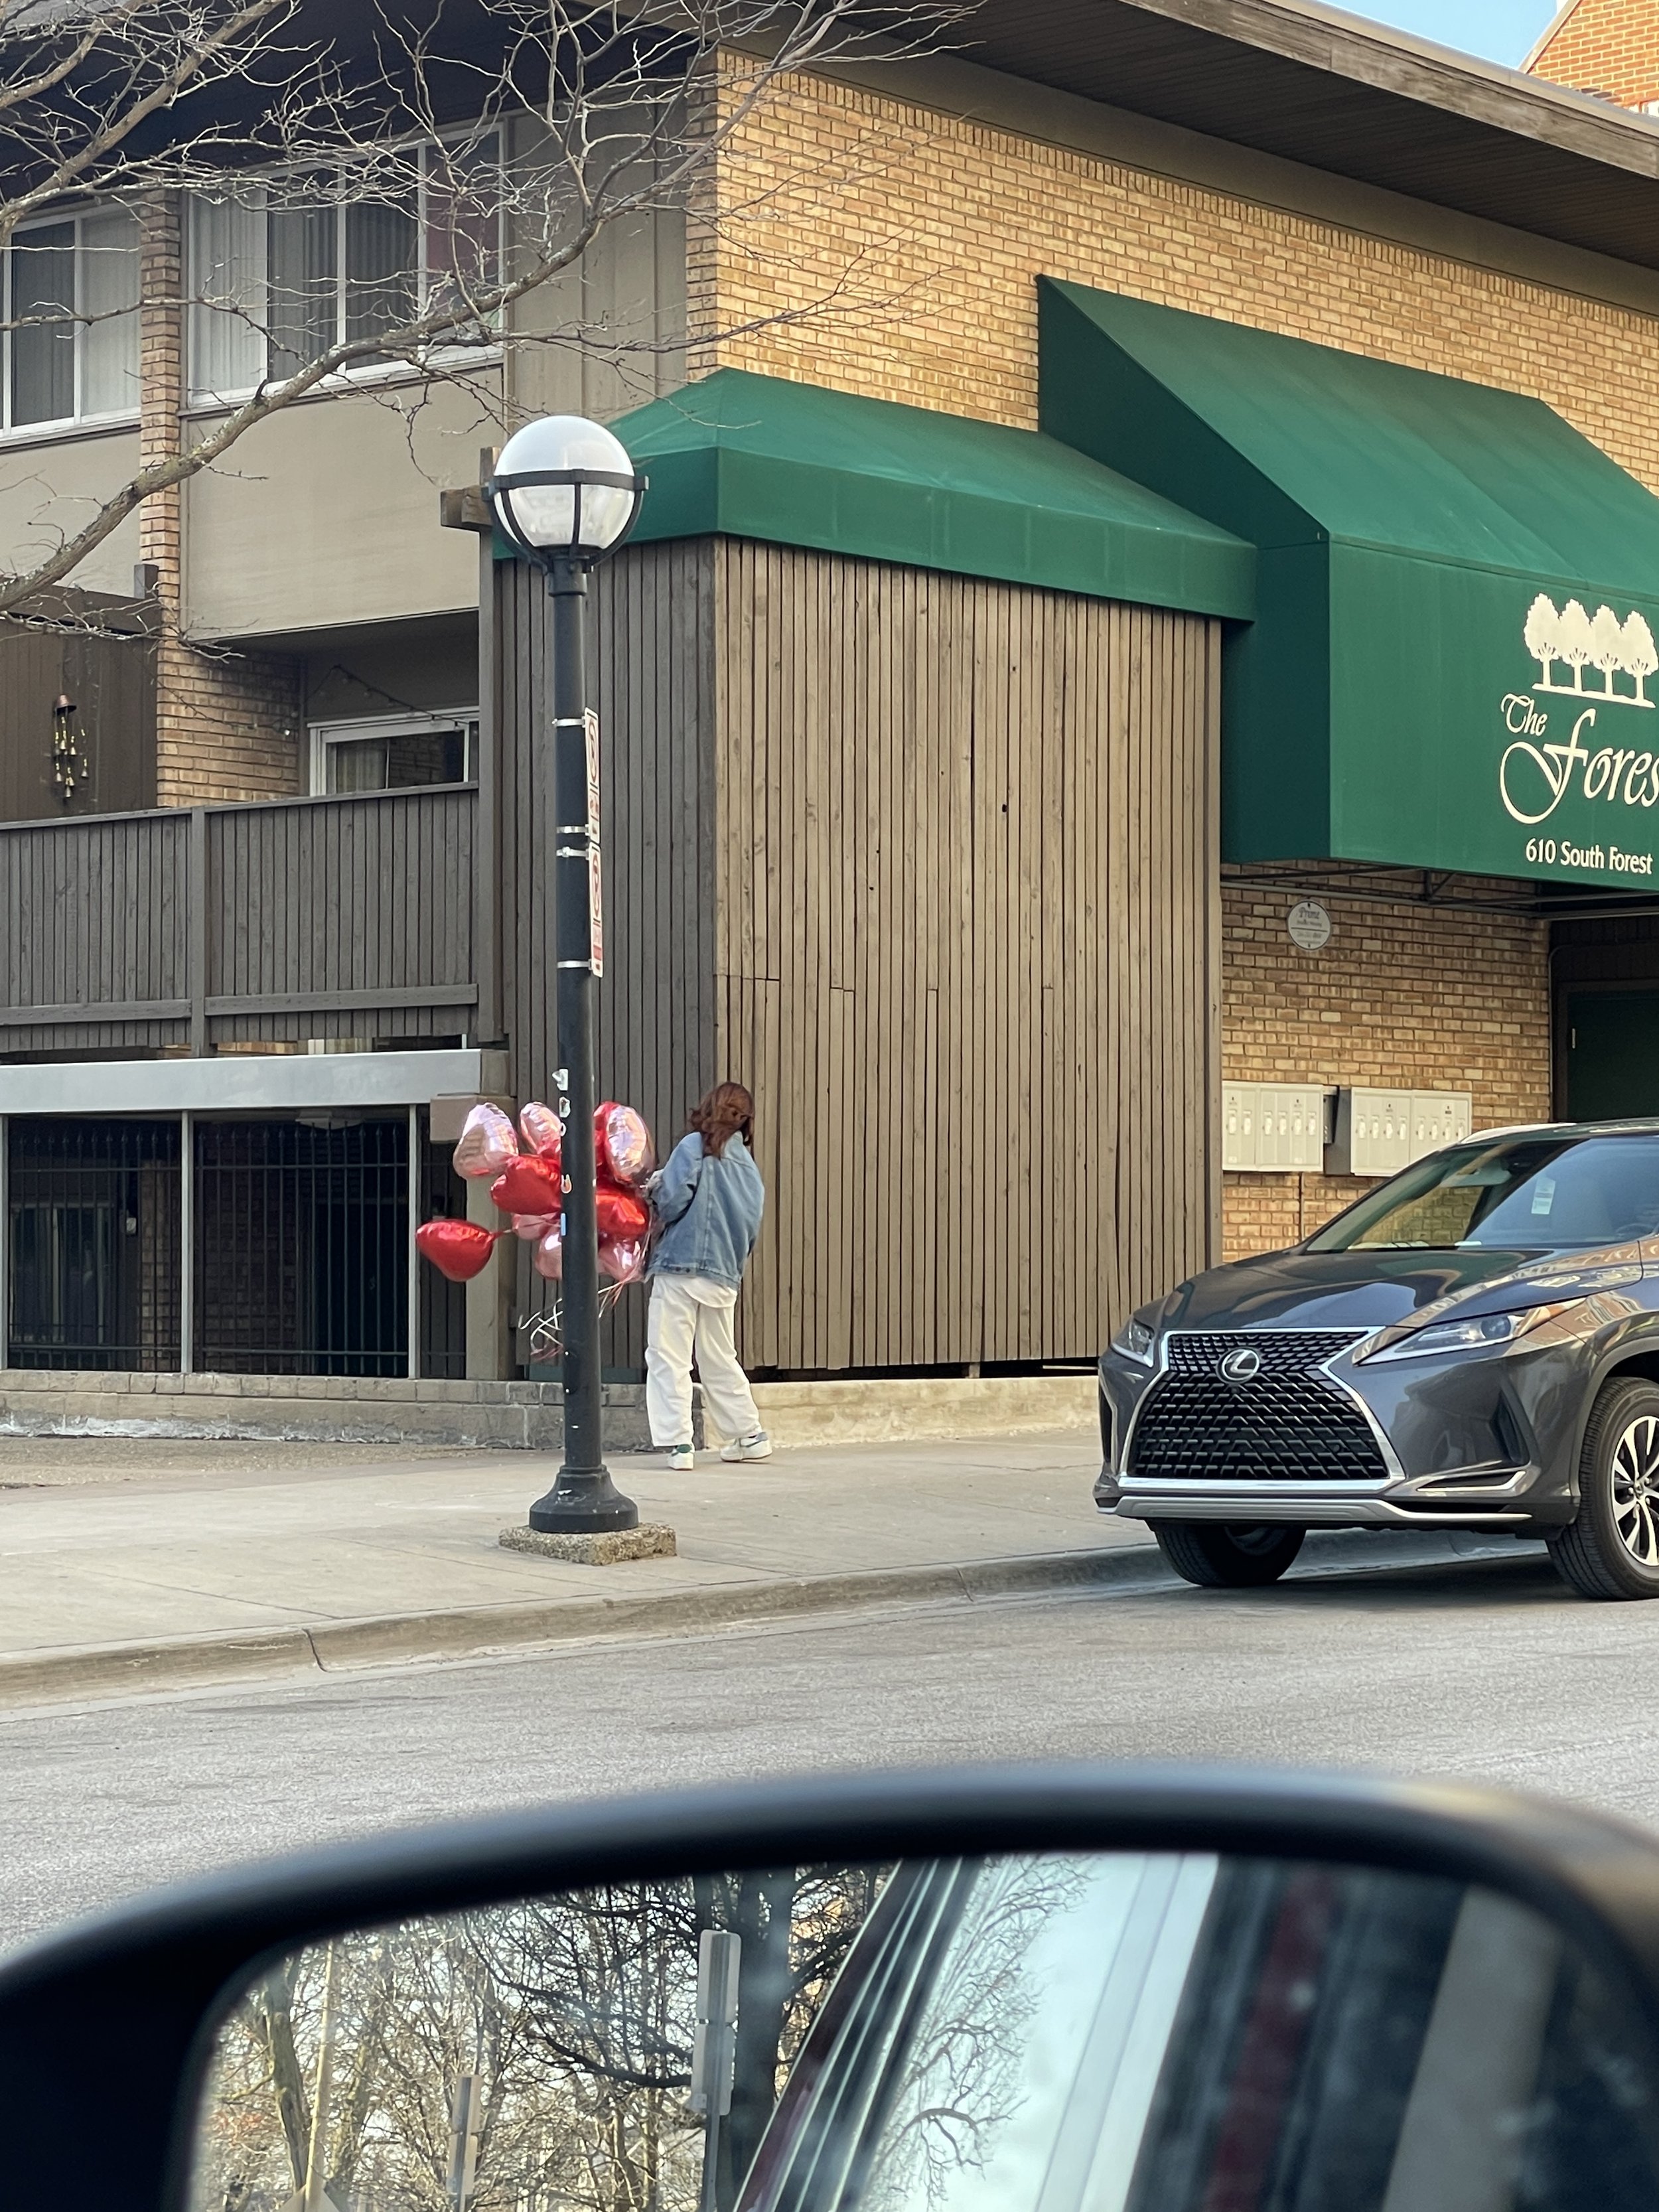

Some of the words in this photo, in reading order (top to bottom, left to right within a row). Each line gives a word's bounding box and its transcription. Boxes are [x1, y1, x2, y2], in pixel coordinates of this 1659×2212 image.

[1500, 694, 1548, 737] The
[1526, 838, 1557, 864] 610
[1560, 841, 1605, 869] South
[1609, 846, 1654, 875] Forest
